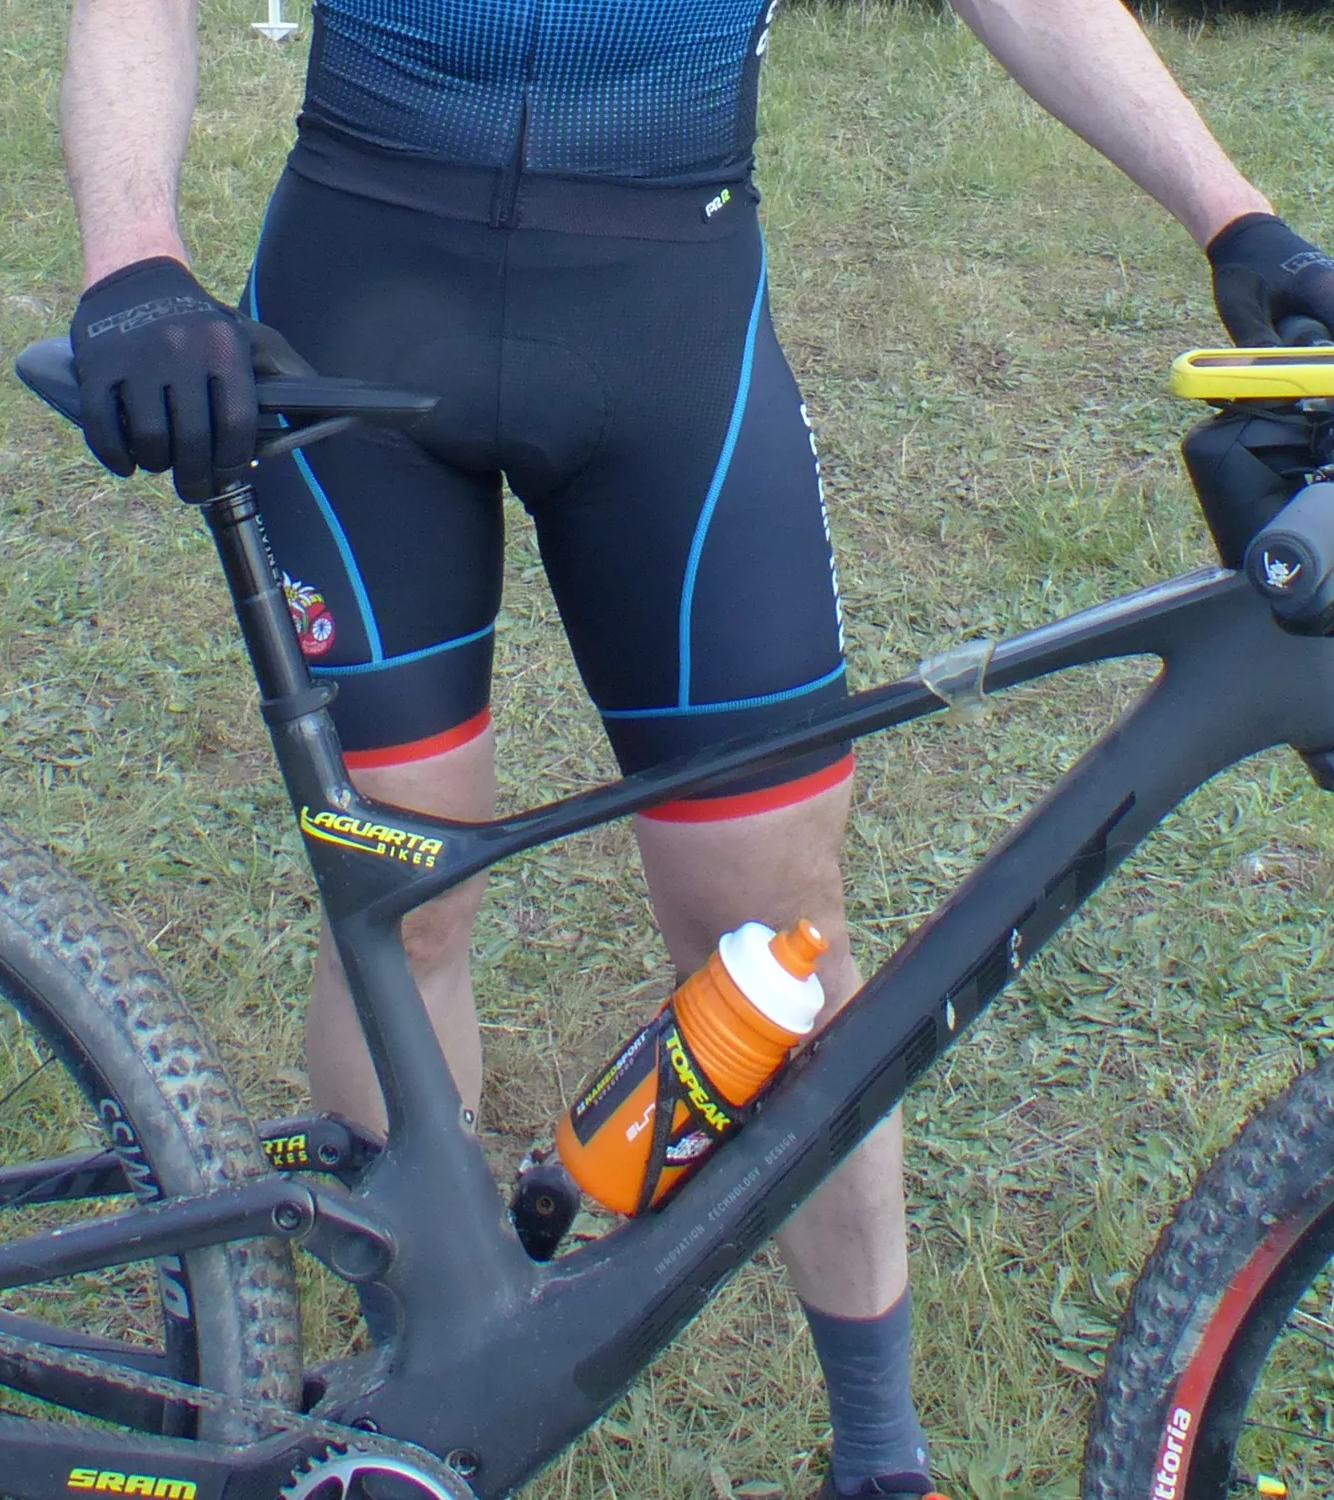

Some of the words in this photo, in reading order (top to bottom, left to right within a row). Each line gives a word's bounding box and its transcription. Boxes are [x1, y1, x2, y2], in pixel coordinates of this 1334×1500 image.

[301, 806, 443, 855] LAGUARTA
[377, 843, 436, 868] BIKES
[666, 1027, 731, 1132] TOPEAK
[100, 1098, 160, 1200] WISS
[273, 1151, 309, 1166] KES
[655, 1223, 705, 1275] INNOVATION
[708, 1167, 761, 1221] TECHNOLOGY
[764, 1132, 797, 1165] DESIGN
[68, 1468, 197, 1500] SRAM
[1154, 1407, 1192, 1500] ttoria
